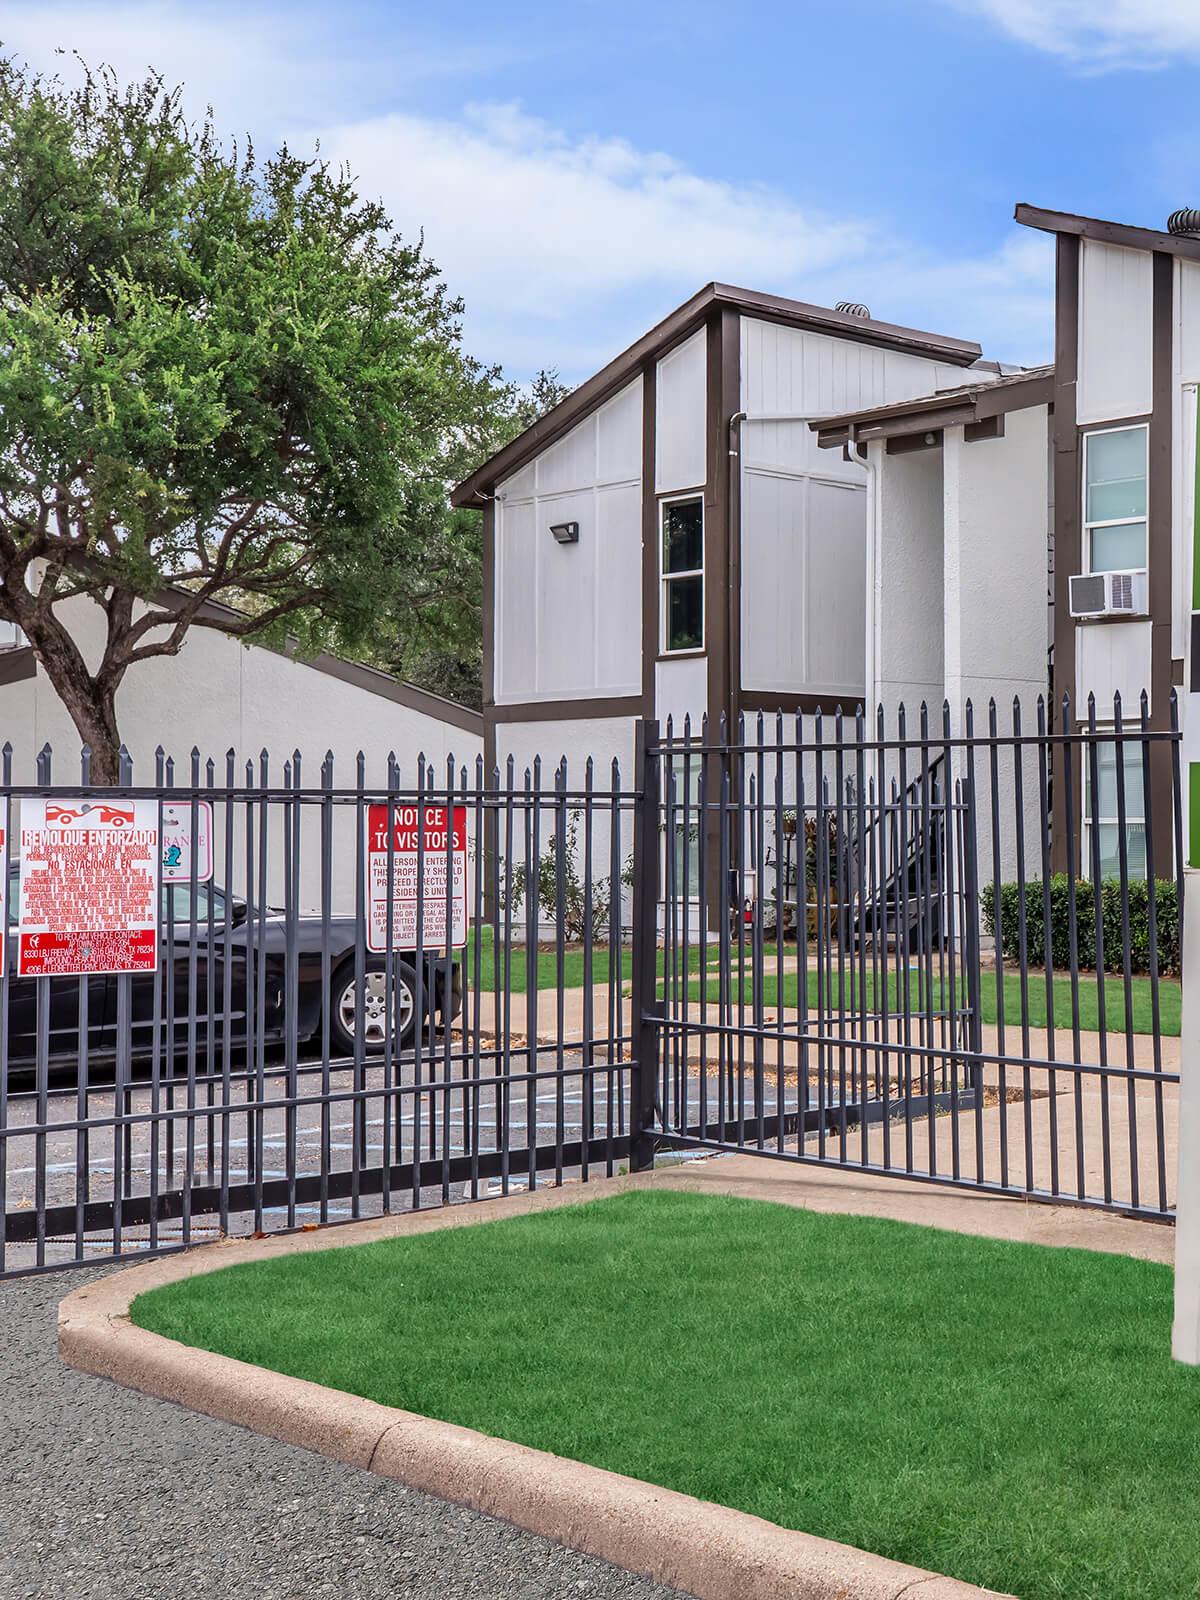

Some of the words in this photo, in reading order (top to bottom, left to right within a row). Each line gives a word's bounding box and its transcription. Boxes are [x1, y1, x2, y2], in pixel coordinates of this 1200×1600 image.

[394, 809, 444, 826] NOTCE
[91, 830, 154, 846] ENFORZADO
[397, 831, 459, 849] VISTORS
[48, 861, 59, 869] NO
[65, 860, 115, 869] ESTACIONAR
[121, 860, 132, 869] EN
[394, 857, 418, 866] ERSON
[426, 856, 461, 865] ENTERNG
[433, 867, 462, 875] SHOLD
[376, 878, 411, 886] PRCEED
[393, 932, 415, 940] UBJECT
